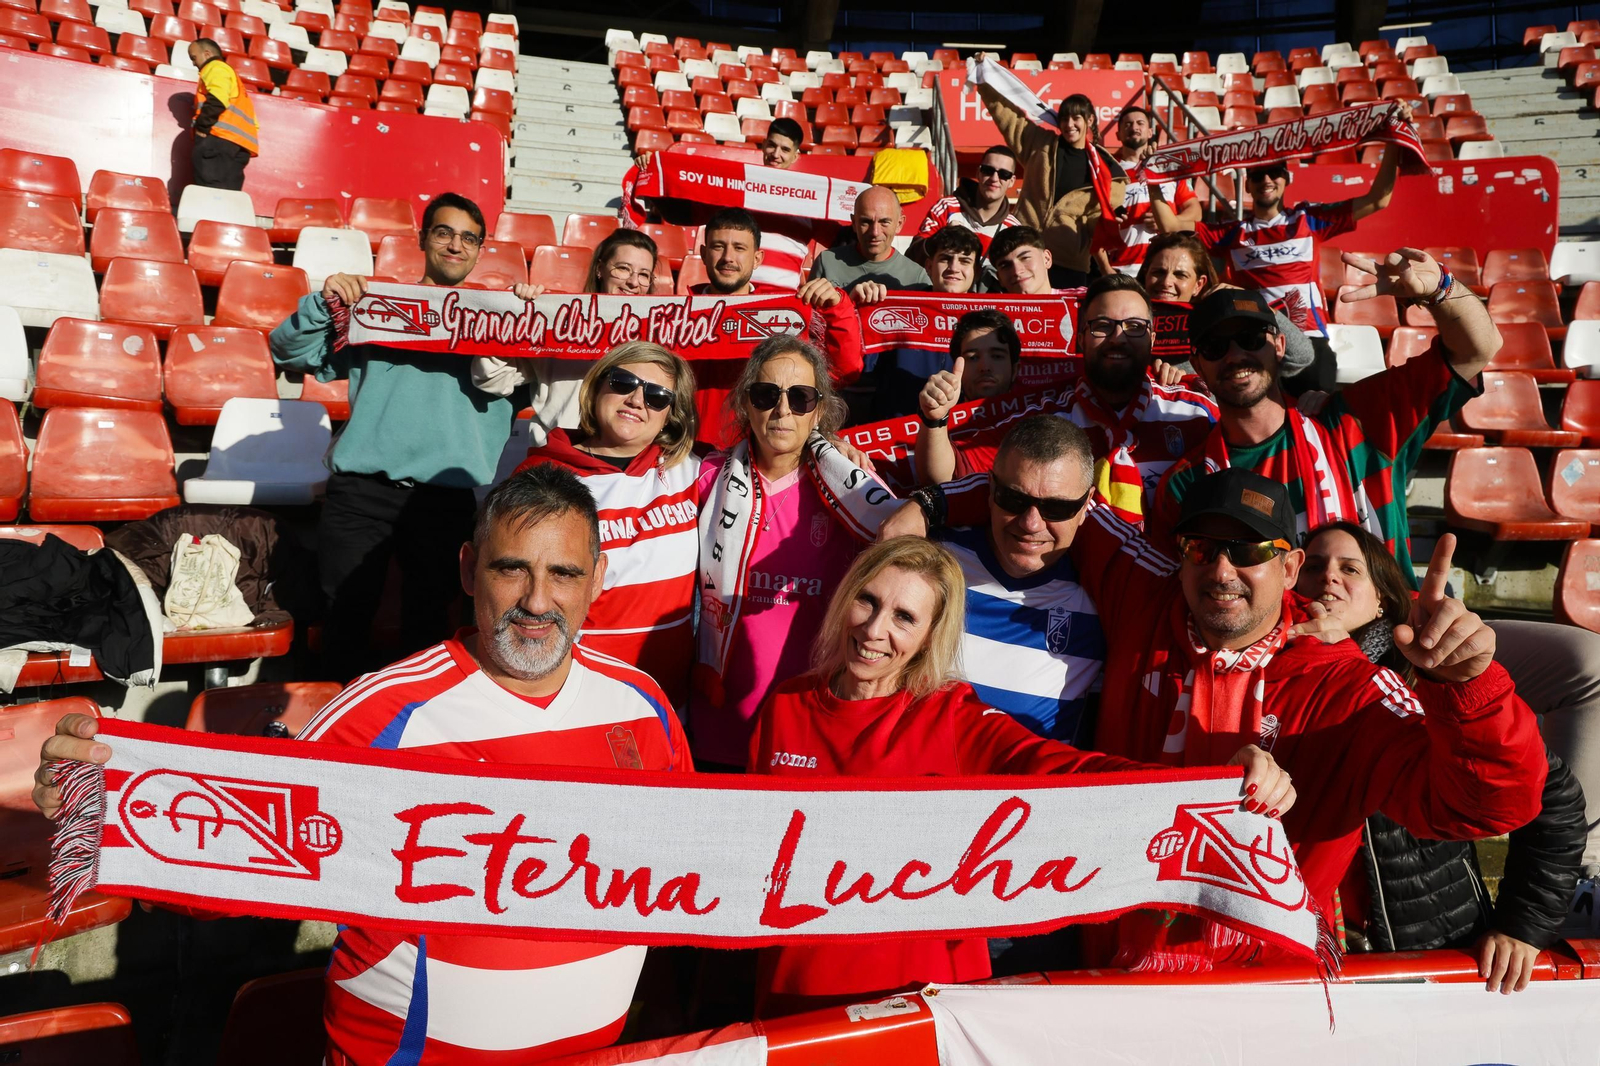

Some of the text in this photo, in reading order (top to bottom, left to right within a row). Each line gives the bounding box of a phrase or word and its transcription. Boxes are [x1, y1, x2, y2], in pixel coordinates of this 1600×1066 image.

[1200, 131, 1267, 172] Granada
[1273, 119, 1309, 151] Club
[1311, 116, 1332, 144] de
[679, 170, 818, 201] SOY UN HINCHA ESPECIAL
[442, 290, 727, 351] Granada Club de Fútbol
[1022, 305, 1043, 313] FINAL
[598, 499, 698, 543] RNA LUCHA
[747, 570, 822, 596] mara
[748, 594, 790, 606] ranada
[392, 796, 1102, 929] Eterna Lucha
